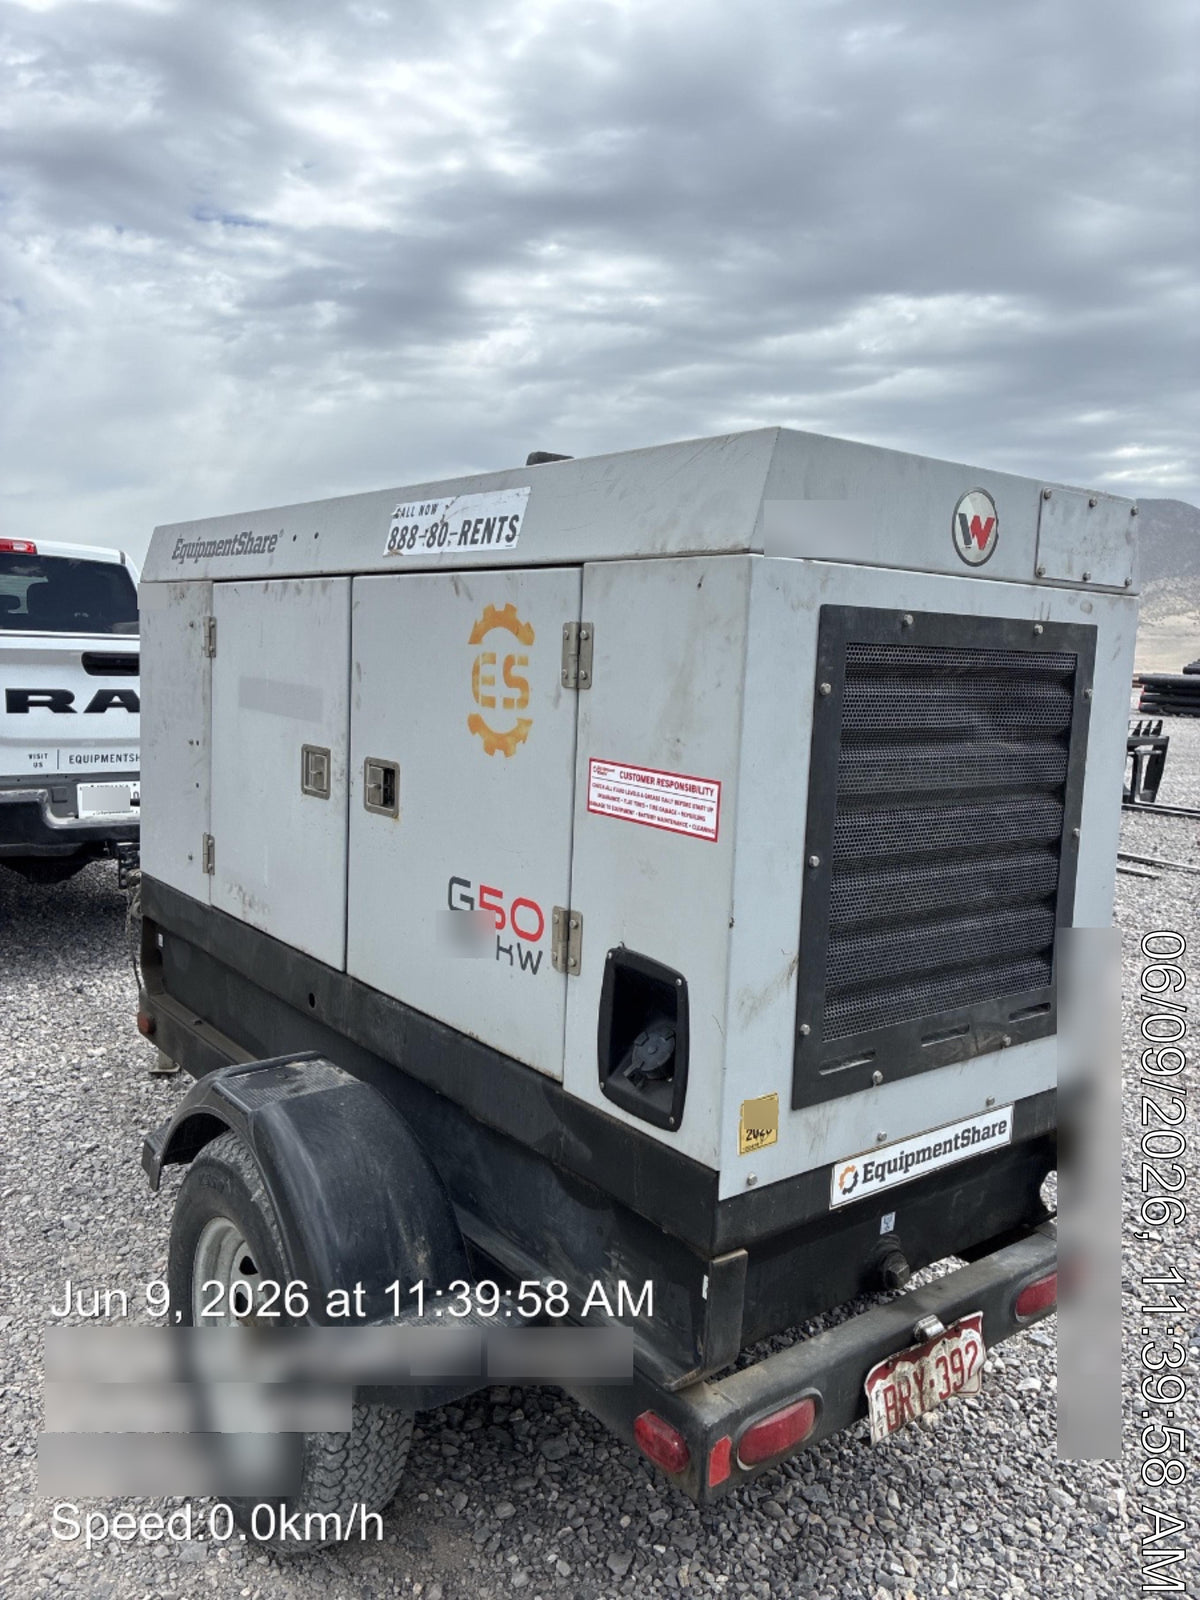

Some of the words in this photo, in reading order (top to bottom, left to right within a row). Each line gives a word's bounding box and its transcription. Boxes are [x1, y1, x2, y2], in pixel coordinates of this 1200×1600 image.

[418, 503, 440, 517] NOW
[388, 514, 520, 551] 888-80-RENTS
[471, 651, 530, 710] ES
[28, 752, 48, 760] VISIT
[619, 770, 655, 787] CUSTOMER
[656, 777, 715, 797] RESPONSIBILITY
[448, 875, 545, 943] G50
[861, 1119, 1008, 1184] EquipmentShare
